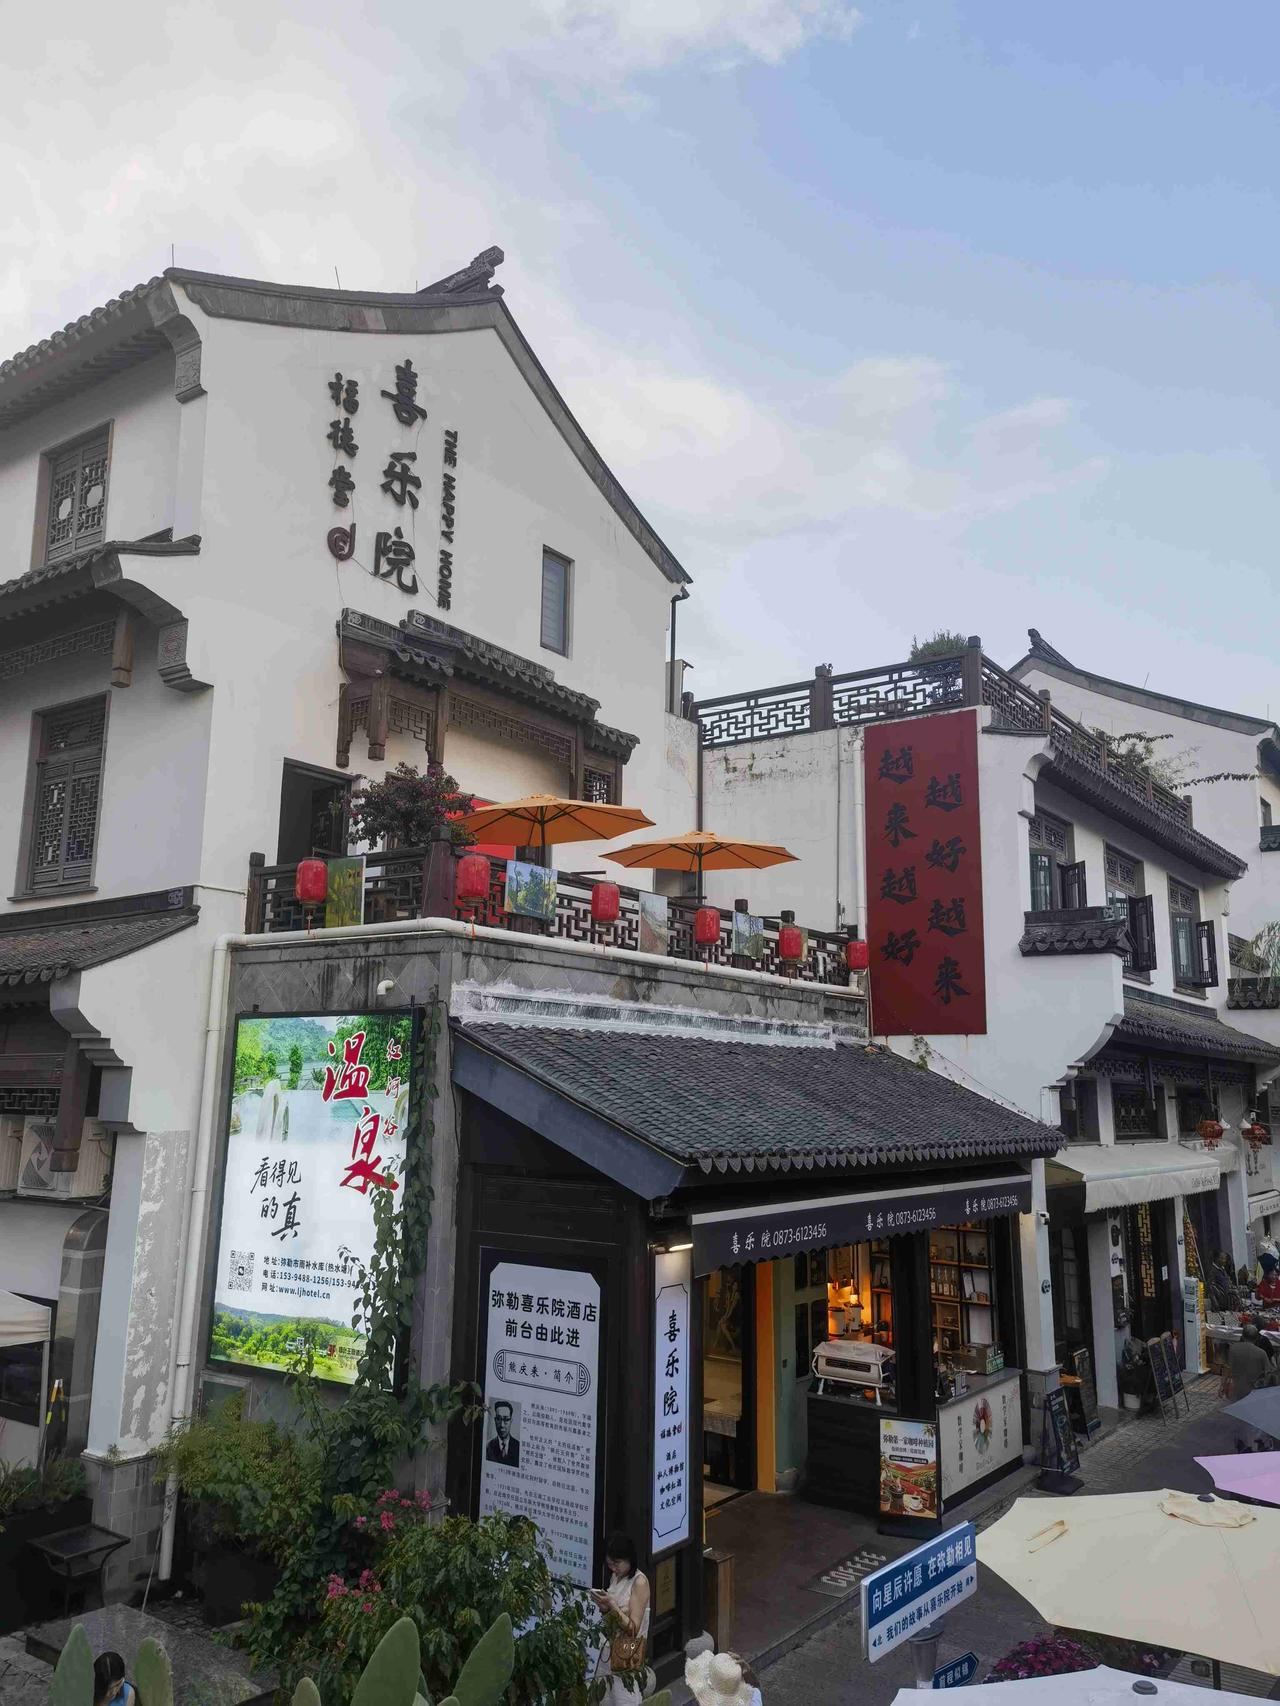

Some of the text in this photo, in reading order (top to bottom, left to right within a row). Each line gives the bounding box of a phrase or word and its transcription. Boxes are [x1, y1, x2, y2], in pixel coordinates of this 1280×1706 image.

[444, 429, 458, 468] THE
[374, 359, 427, 594] 喜乐院
[441, 472, 456, 544] HAPPY
[877, 745, 922, 967] 越来越好
[924, 772, 971, 1004] 越好越来
[250, 1156, 302, 1194] 看得见
[260, 1191, 301, 1241] 的真
[865, 1207, 937, 1231] 喜乐院 0873-6123456
[964, 1195, 1018, 1215] 喜乐院 0873-6123456
[730, 1223, 827, 1254] 喜乐院 0873-6123456
[491, 1289, 597, 1322] 弥勒喜乐院酒店
[504, 1318, 580, 1348] 前台由此进
[662, 1310, 681, 1417] 喜乐院
[872, 1535, 972, 1614] 向星辰许愿 在弥勒相见
[886, 1581, 963, 1642] 我们的故事从喜乐院开始
